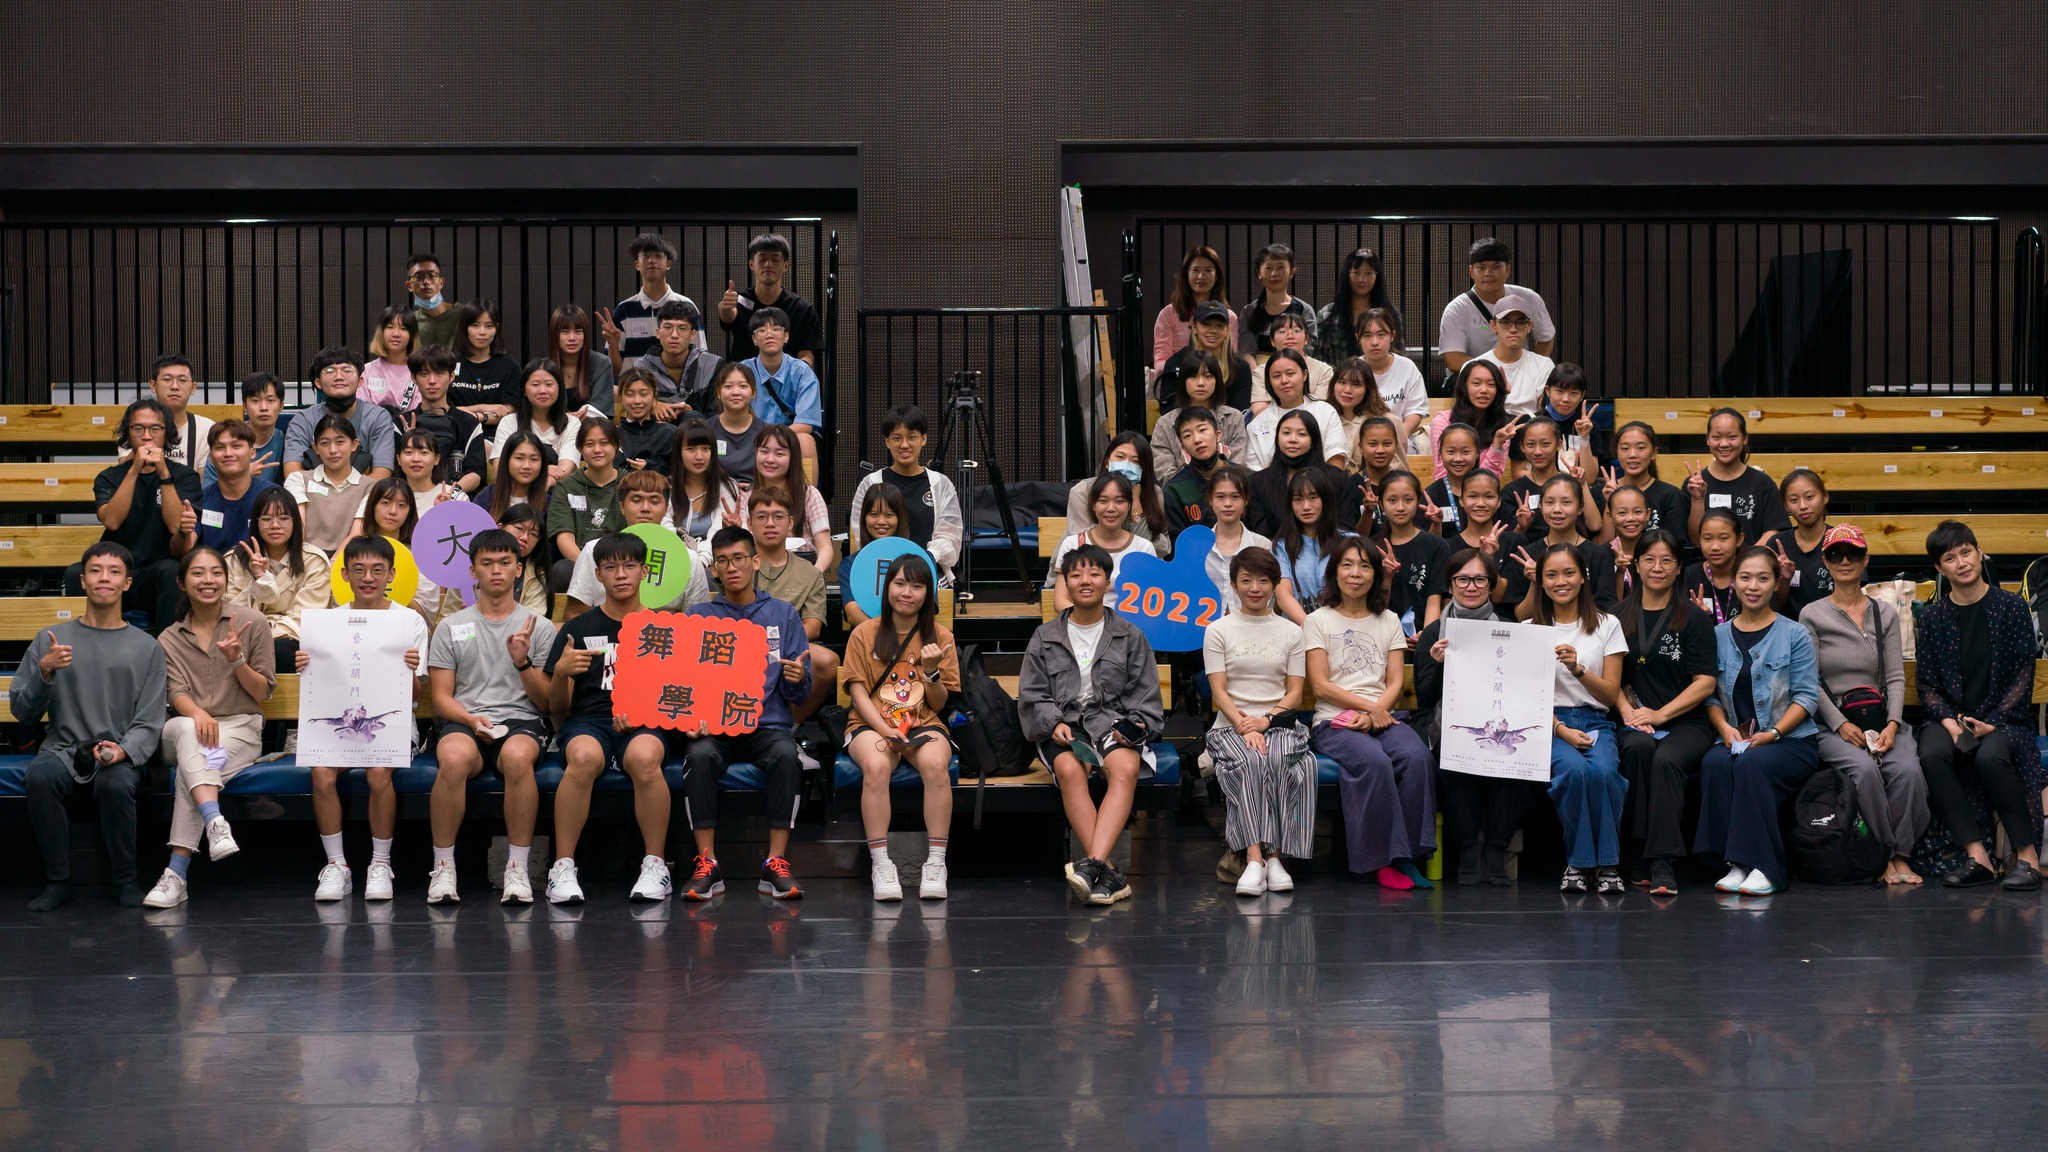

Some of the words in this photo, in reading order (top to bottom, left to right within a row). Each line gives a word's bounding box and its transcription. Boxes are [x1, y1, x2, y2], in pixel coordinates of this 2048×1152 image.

[1184, 504, 1202, 522] 10
[437, 524, 473, 566] 大
[1118, 582, 1218, 627] 2022
